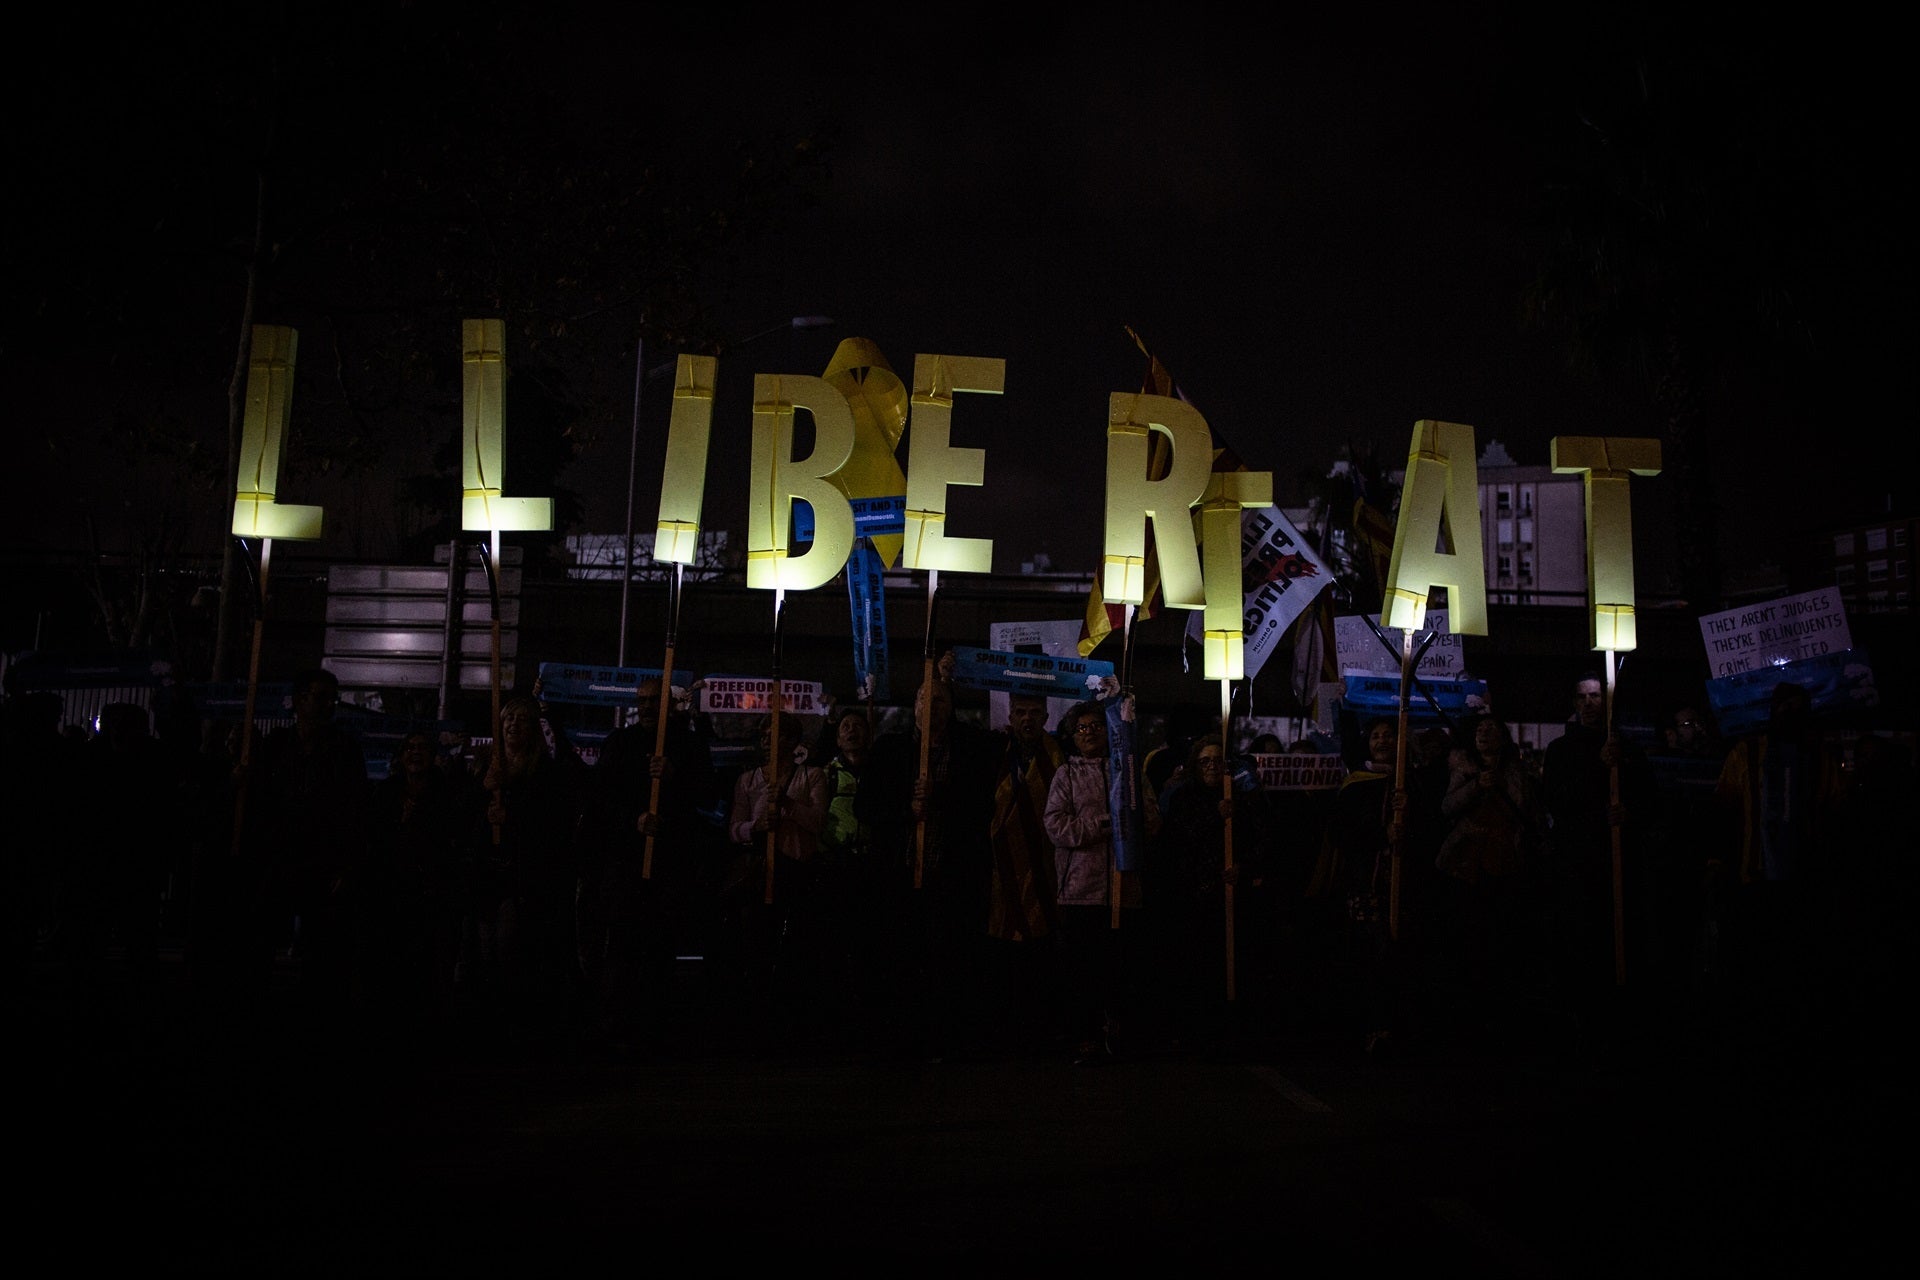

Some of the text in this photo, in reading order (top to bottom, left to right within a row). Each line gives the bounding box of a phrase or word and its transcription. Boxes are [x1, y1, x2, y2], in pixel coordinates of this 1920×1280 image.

[871, 500, 891, 512] AND
[1708, 616, 1736, 634] THEY
[1781, 595, 1830, 618] JUDGES
[1758, 613, 1843, 643] DELINQUENTS
[976, 653, 1087, 673] SPAIN, SIT AND TALK!
[1718, 657, 1755, 677] CRIME
[616, 673, 637, 684] AND
[784, 682, 813, 693] FOR
[1261, 769, 1341, 786] ATALONIA
